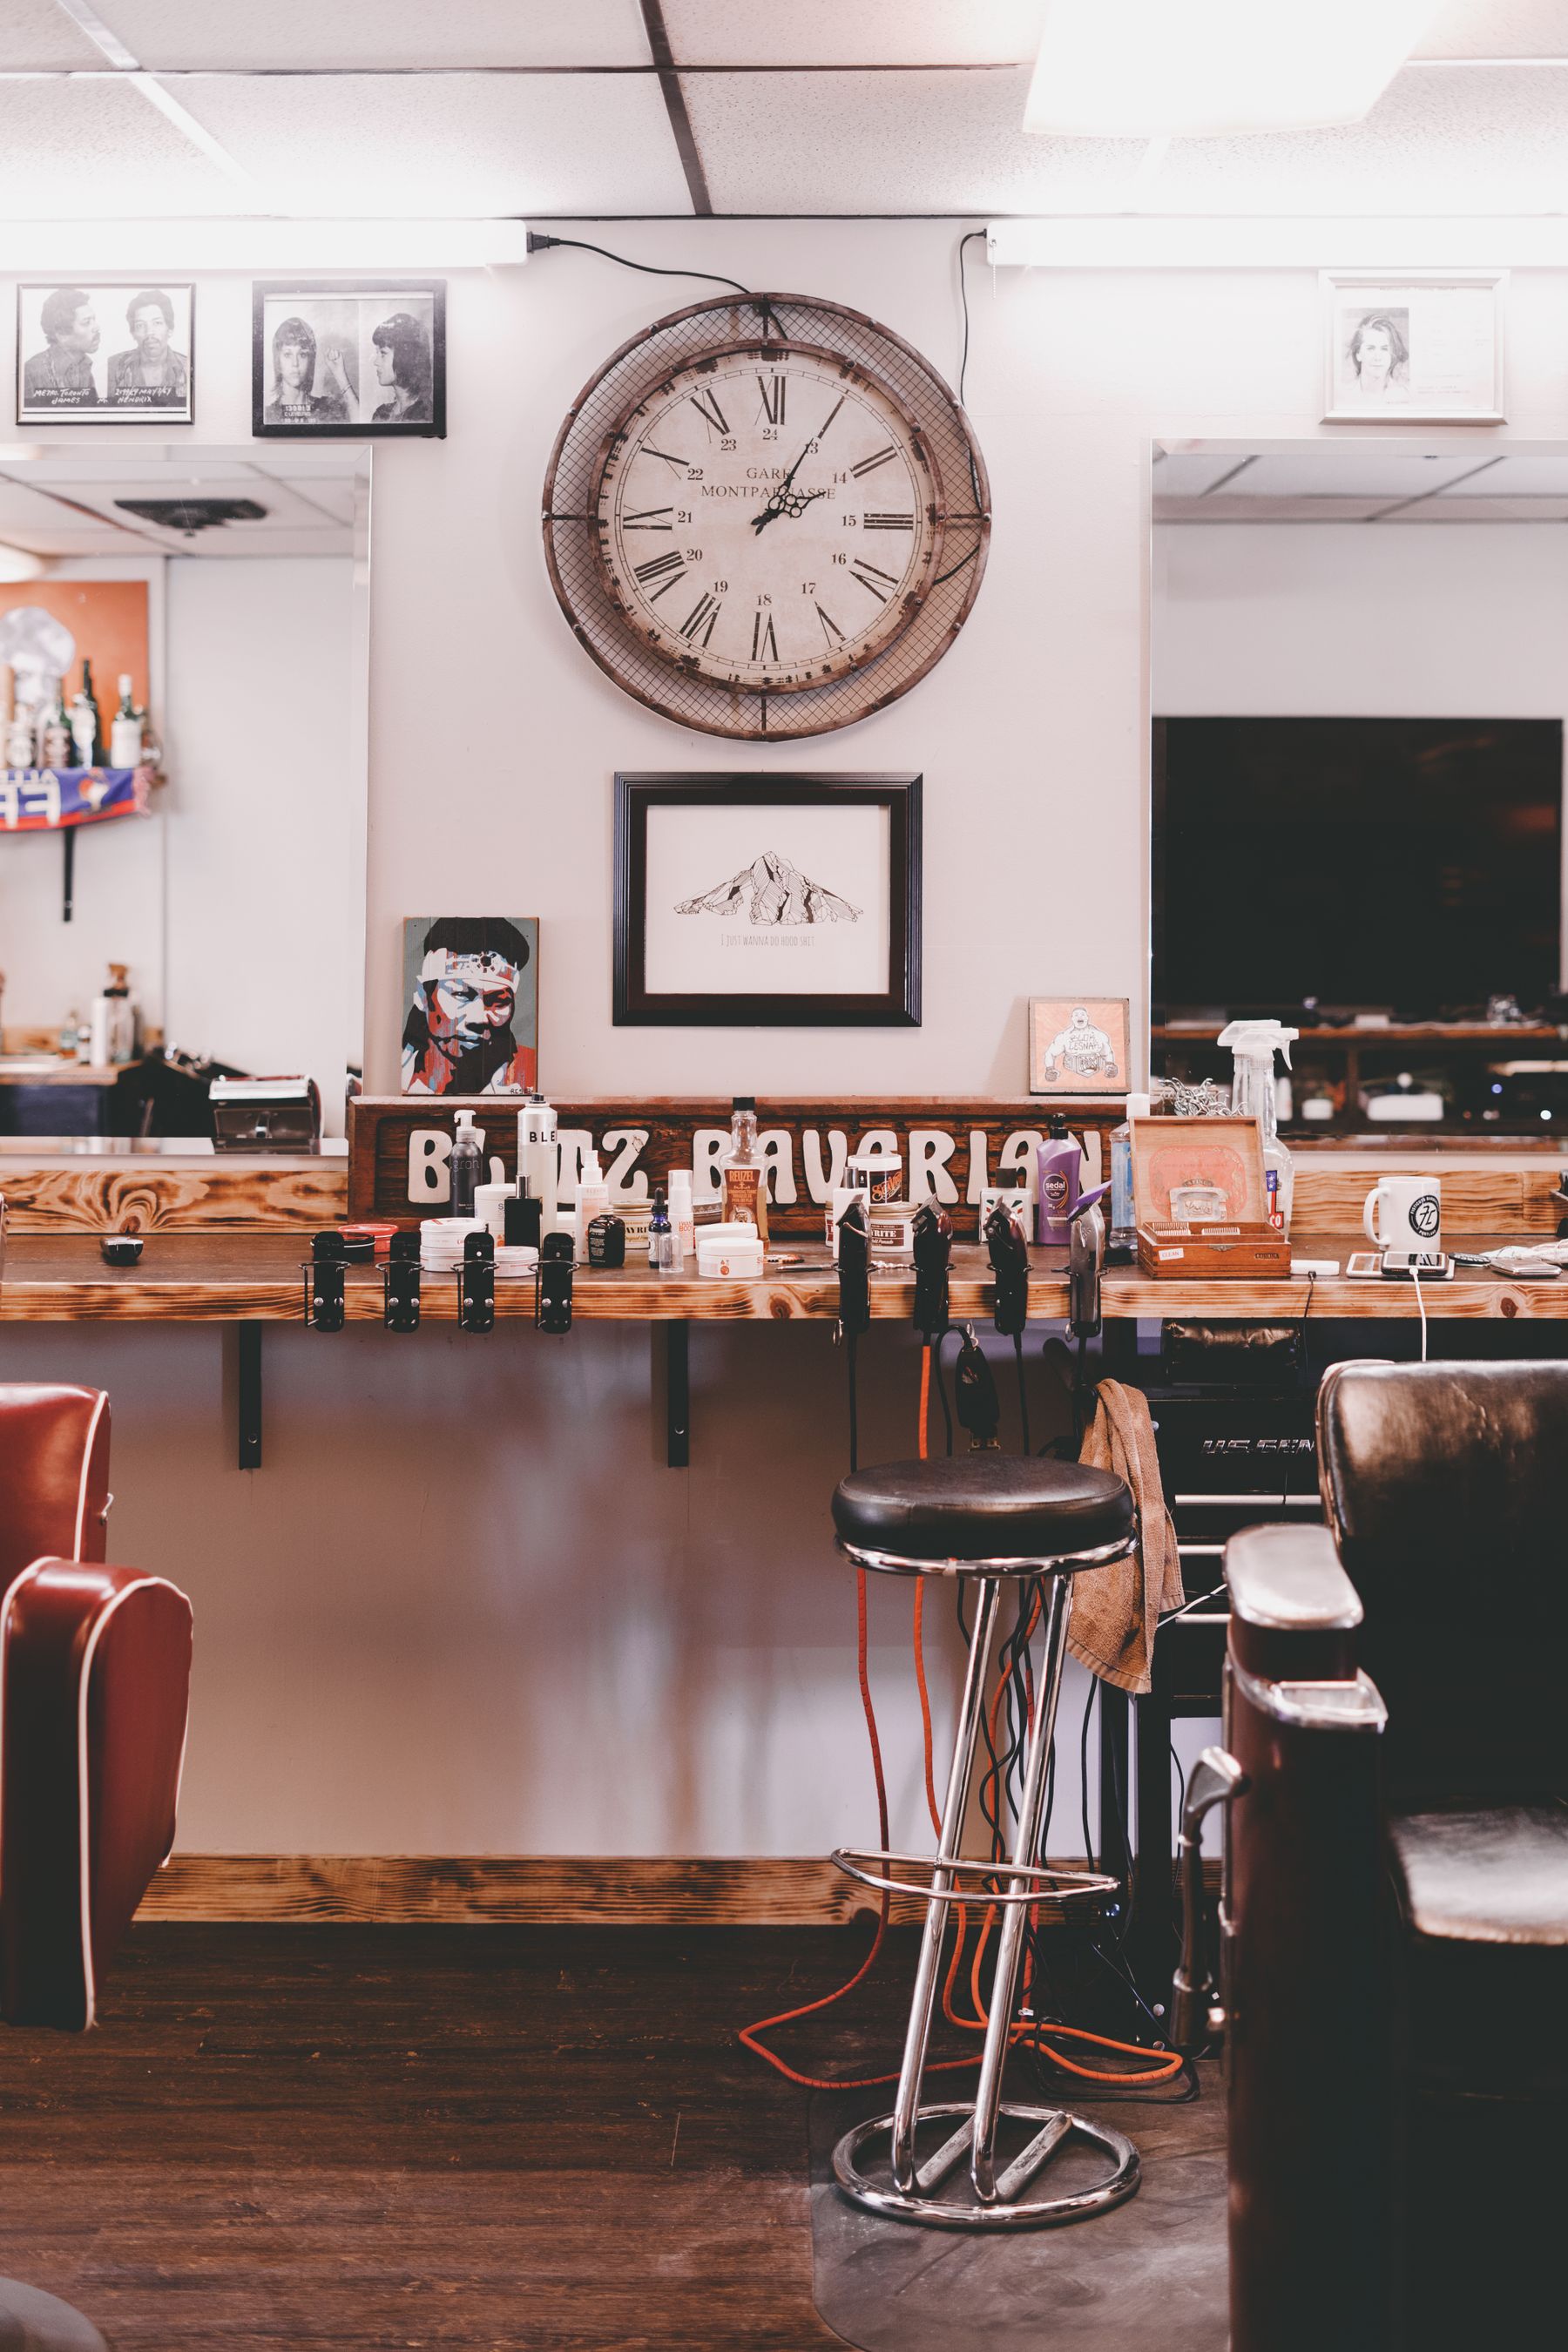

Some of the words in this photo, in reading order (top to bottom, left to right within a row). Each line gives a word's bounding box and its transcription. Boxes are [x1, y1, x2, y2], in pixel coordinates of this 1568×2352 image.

[762, 429, 778, 440] 24
[720, 439, 737, 451] 23
[805, 442, 819, 454] 13
[687, 469, 704, 480] 22
[833, 472, 847, 483] 14
[678, 511, 693, 523] 21
[842, 515, 856, 526] 15
[686, 549, 703, 561] 20
[831, 553, 847, 564] 16
[713, 581, 728, 592] 19
[801, 583, 816, 594] 17
[757, 594, 773, 606] 18
[727, 934, 741, 948] JUST
[742, 935, 768, 947] WANNA
[770, 936, 780, 947] DO
[781, 936, 799, 947] HOOD
[800, 936, 815, 947] SHIT
[408, 1128, 649, 1205] BTZ
[729, 1170, 754, 1182] REUZEL
[1162, 1250, 1180, 1259] CLEAN
